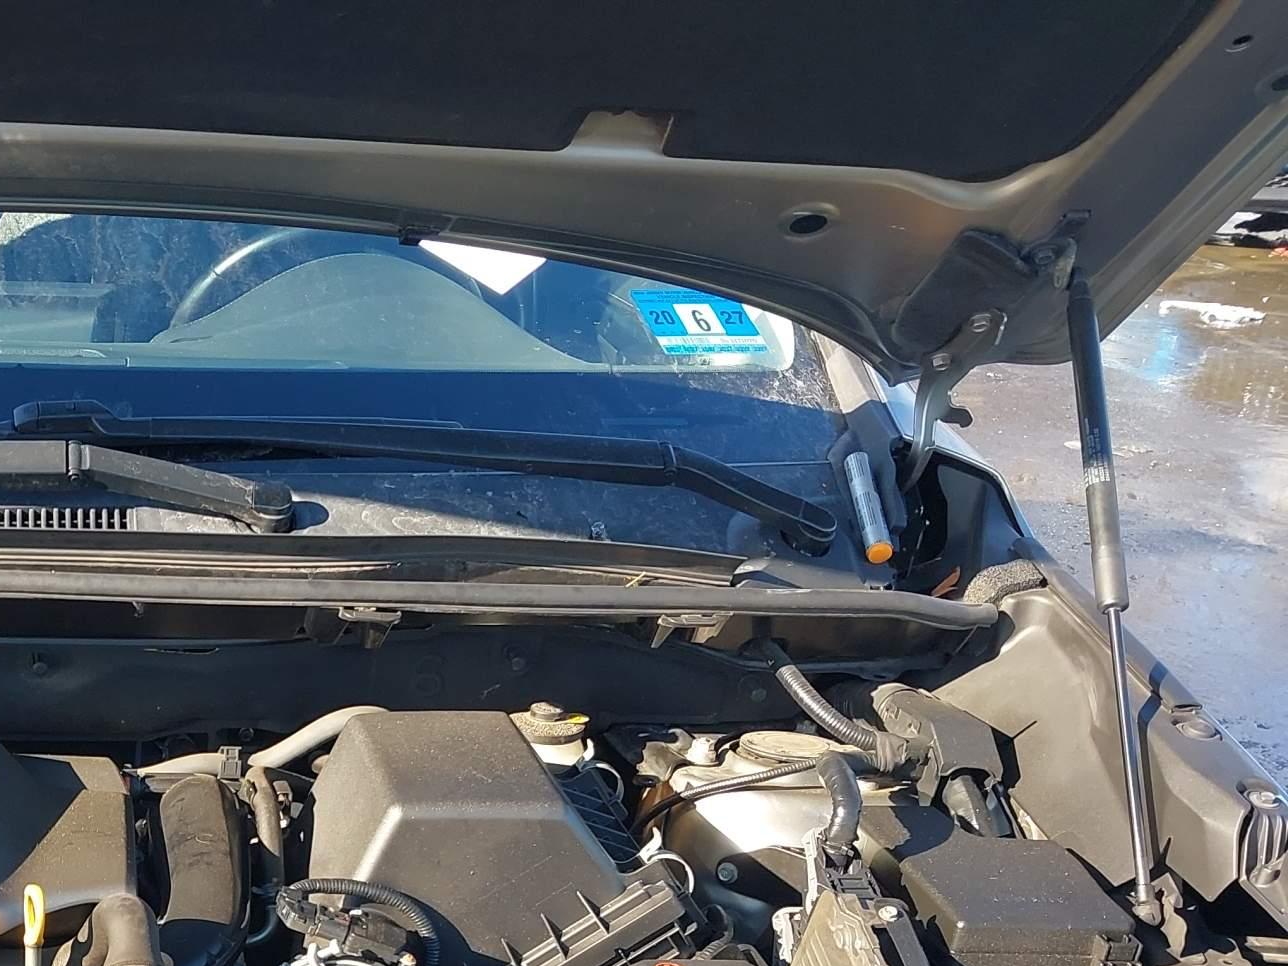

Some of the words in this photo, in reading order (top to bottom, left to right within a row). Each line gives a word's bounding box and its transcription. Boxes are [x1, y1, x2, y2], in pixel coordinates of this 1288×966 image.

[649, 310, 676, 326] 20
[691, 309, 712, 333] 6
[720, 310, 745, 325] 27
